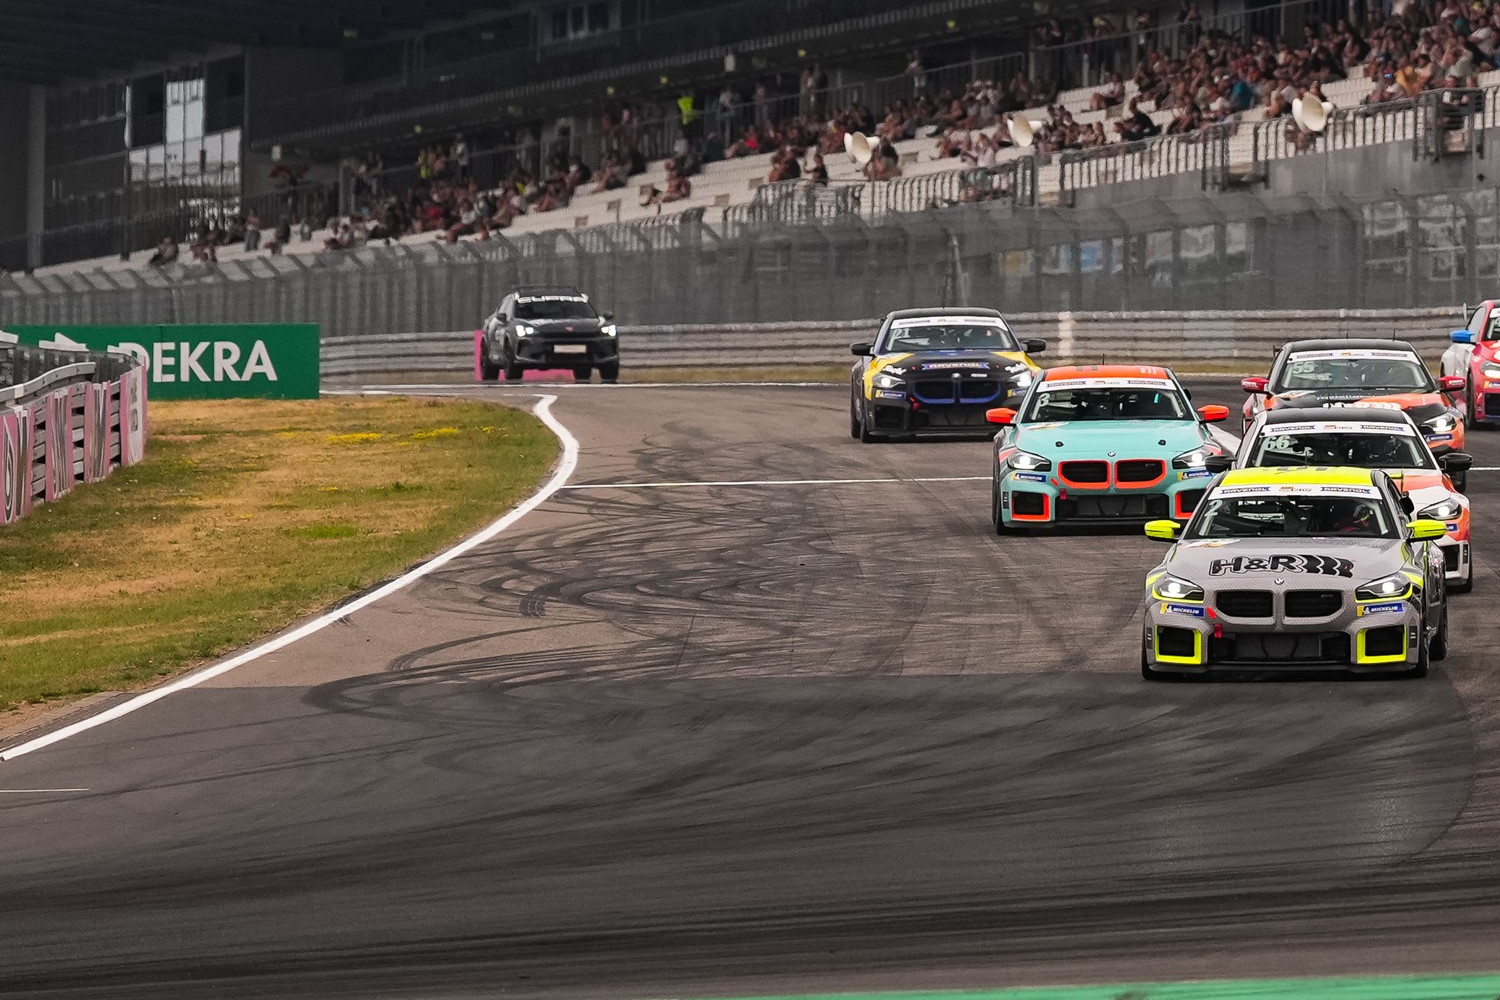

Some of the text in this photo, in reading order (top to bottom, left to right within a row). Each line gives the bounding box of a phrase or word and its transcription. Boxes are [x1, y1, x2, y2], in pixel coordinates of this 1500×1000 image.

[1292, 361, 1315, 374] 55
[1262, 434, 1291, 450] 66
[1224, 486, 1267, 495] RAVENOL
[1323, 486, 1368, 496] RAVENOL
[1209, 554, 1303, 576] H&R
[1172, 607, 1201, 615] MICHELIN
[1370, 604, 1399, 612] MICHELIN
